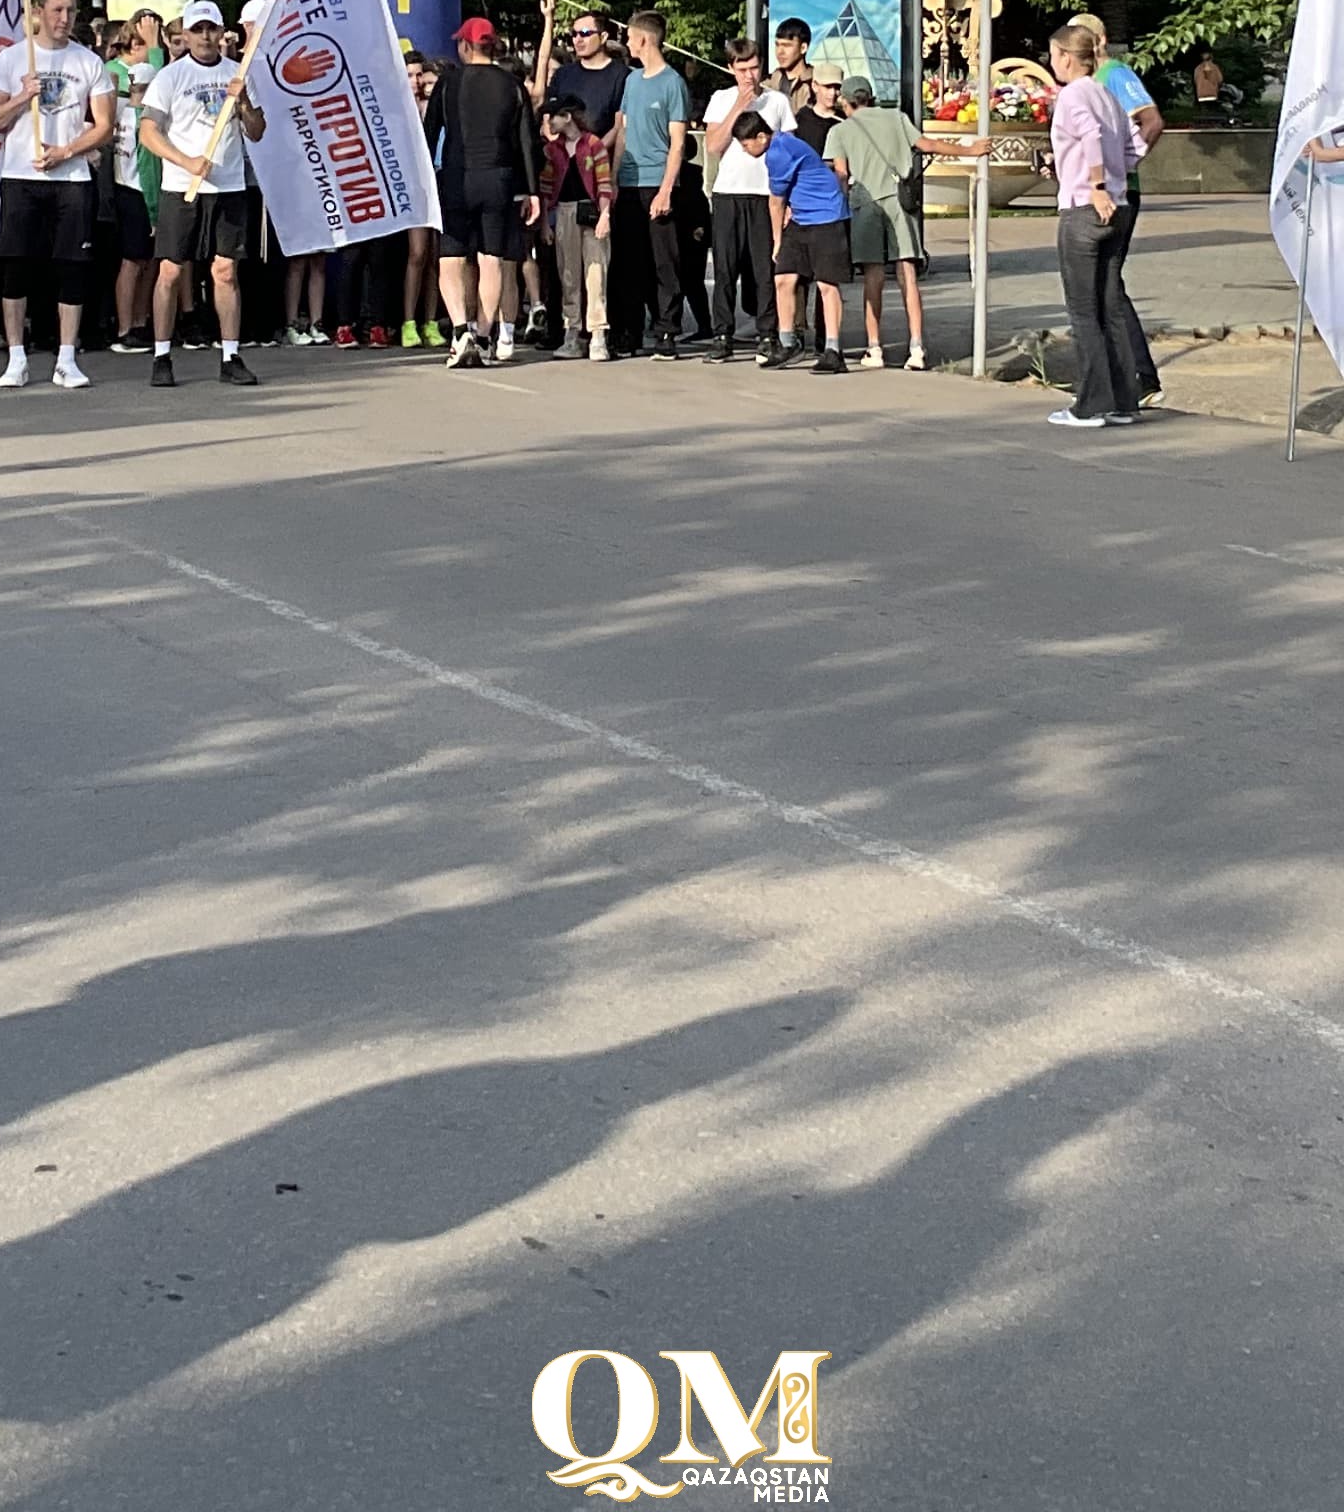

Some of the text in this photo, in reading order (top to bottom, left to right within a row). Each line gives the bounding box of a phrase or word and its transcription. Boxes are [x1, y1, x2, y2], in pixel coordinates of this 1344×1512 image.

[289, 105, 344, 232] НАРКОТИКОВ!
[311, 94, 386, 224] ПРОТИВ
[357, 74, 413, 214] ПЕТРОПАВЛОВСК
